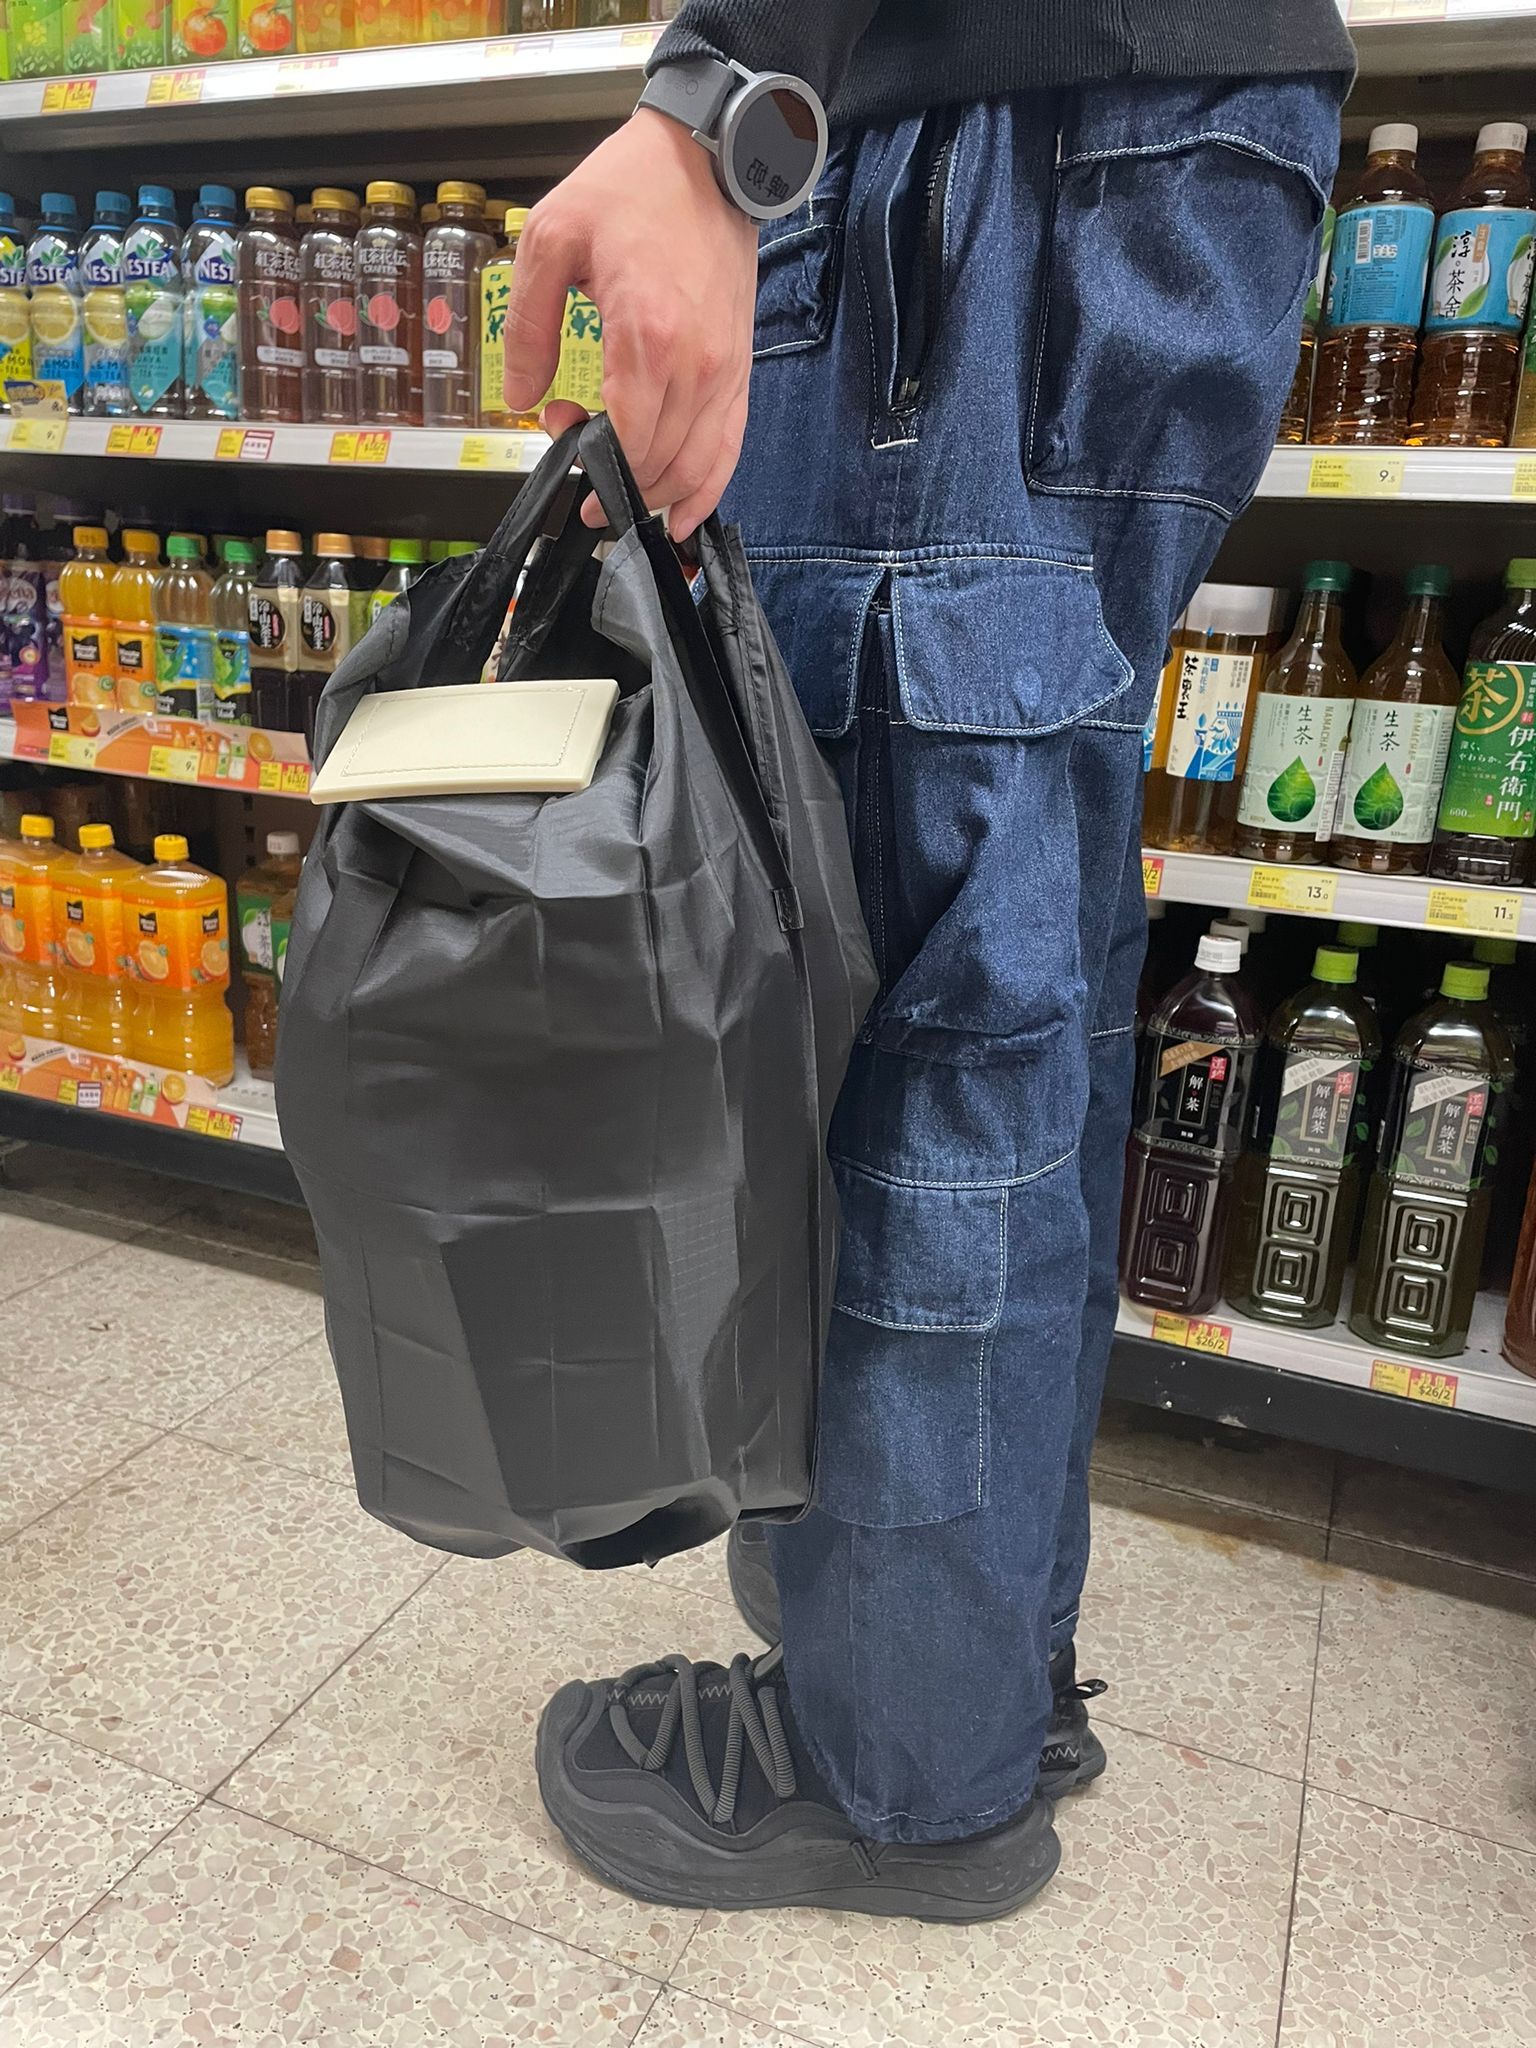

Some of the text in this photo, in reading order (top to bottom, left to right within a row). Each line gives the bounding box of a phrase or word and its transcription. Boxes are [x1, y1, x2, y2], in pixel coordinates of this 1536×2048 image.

[124, 258, 170, 279] ESTEA
[1460, 667, 1508, 723] 茶
[1293, 704, 1314, 745] 生茶
[1379, 709, 1400, 752] 生茶
[1495, 726, 1536, 821] 伊右衛門
[1196, 1335, 1225, 1350] $26/2
[1419, 1385, 1451, 1401] $26/2
